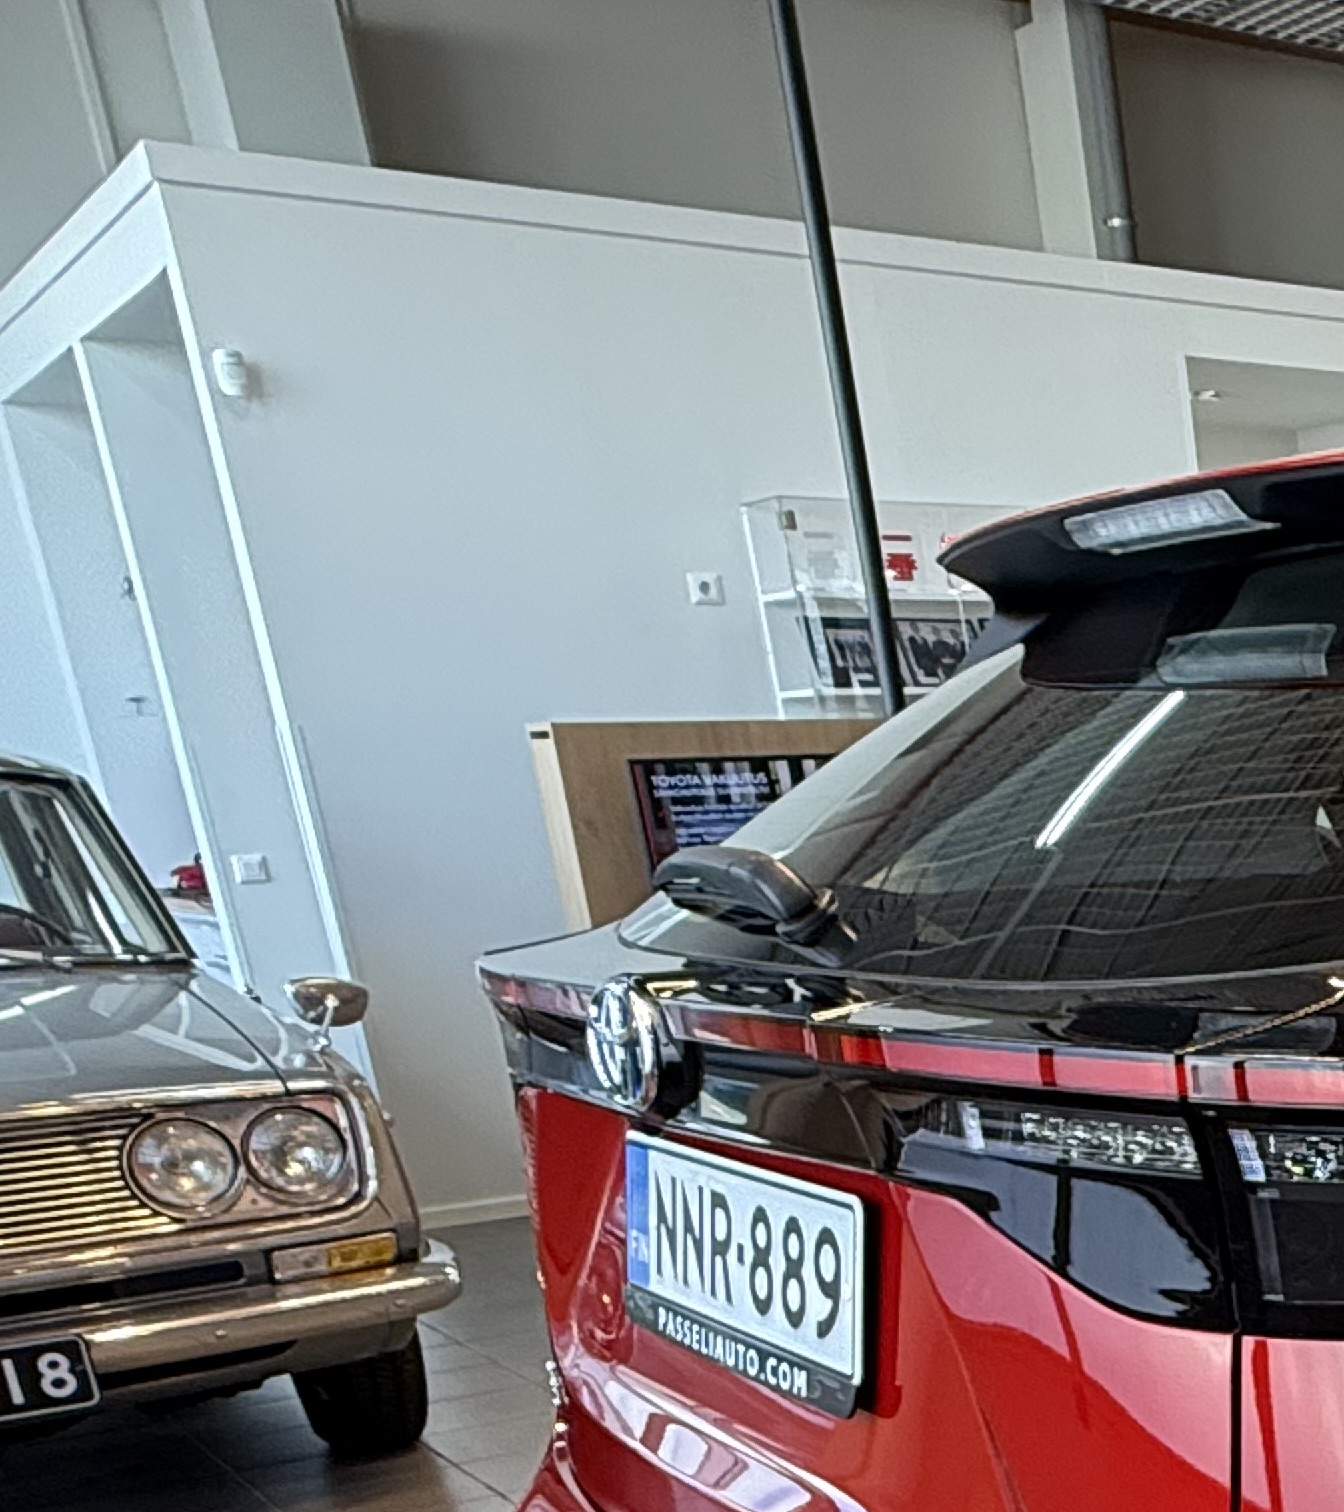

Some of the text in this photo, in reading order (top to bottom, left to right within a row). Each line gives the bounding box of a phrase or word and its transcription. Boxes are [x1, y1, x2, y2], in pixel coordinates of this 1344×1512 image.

[651, 775, 701, 787] TOYOTA
[655, 1171, 841, 1339] NNR-889
[657, 1306, 809, 1398] PASSELIAUTO.COM
